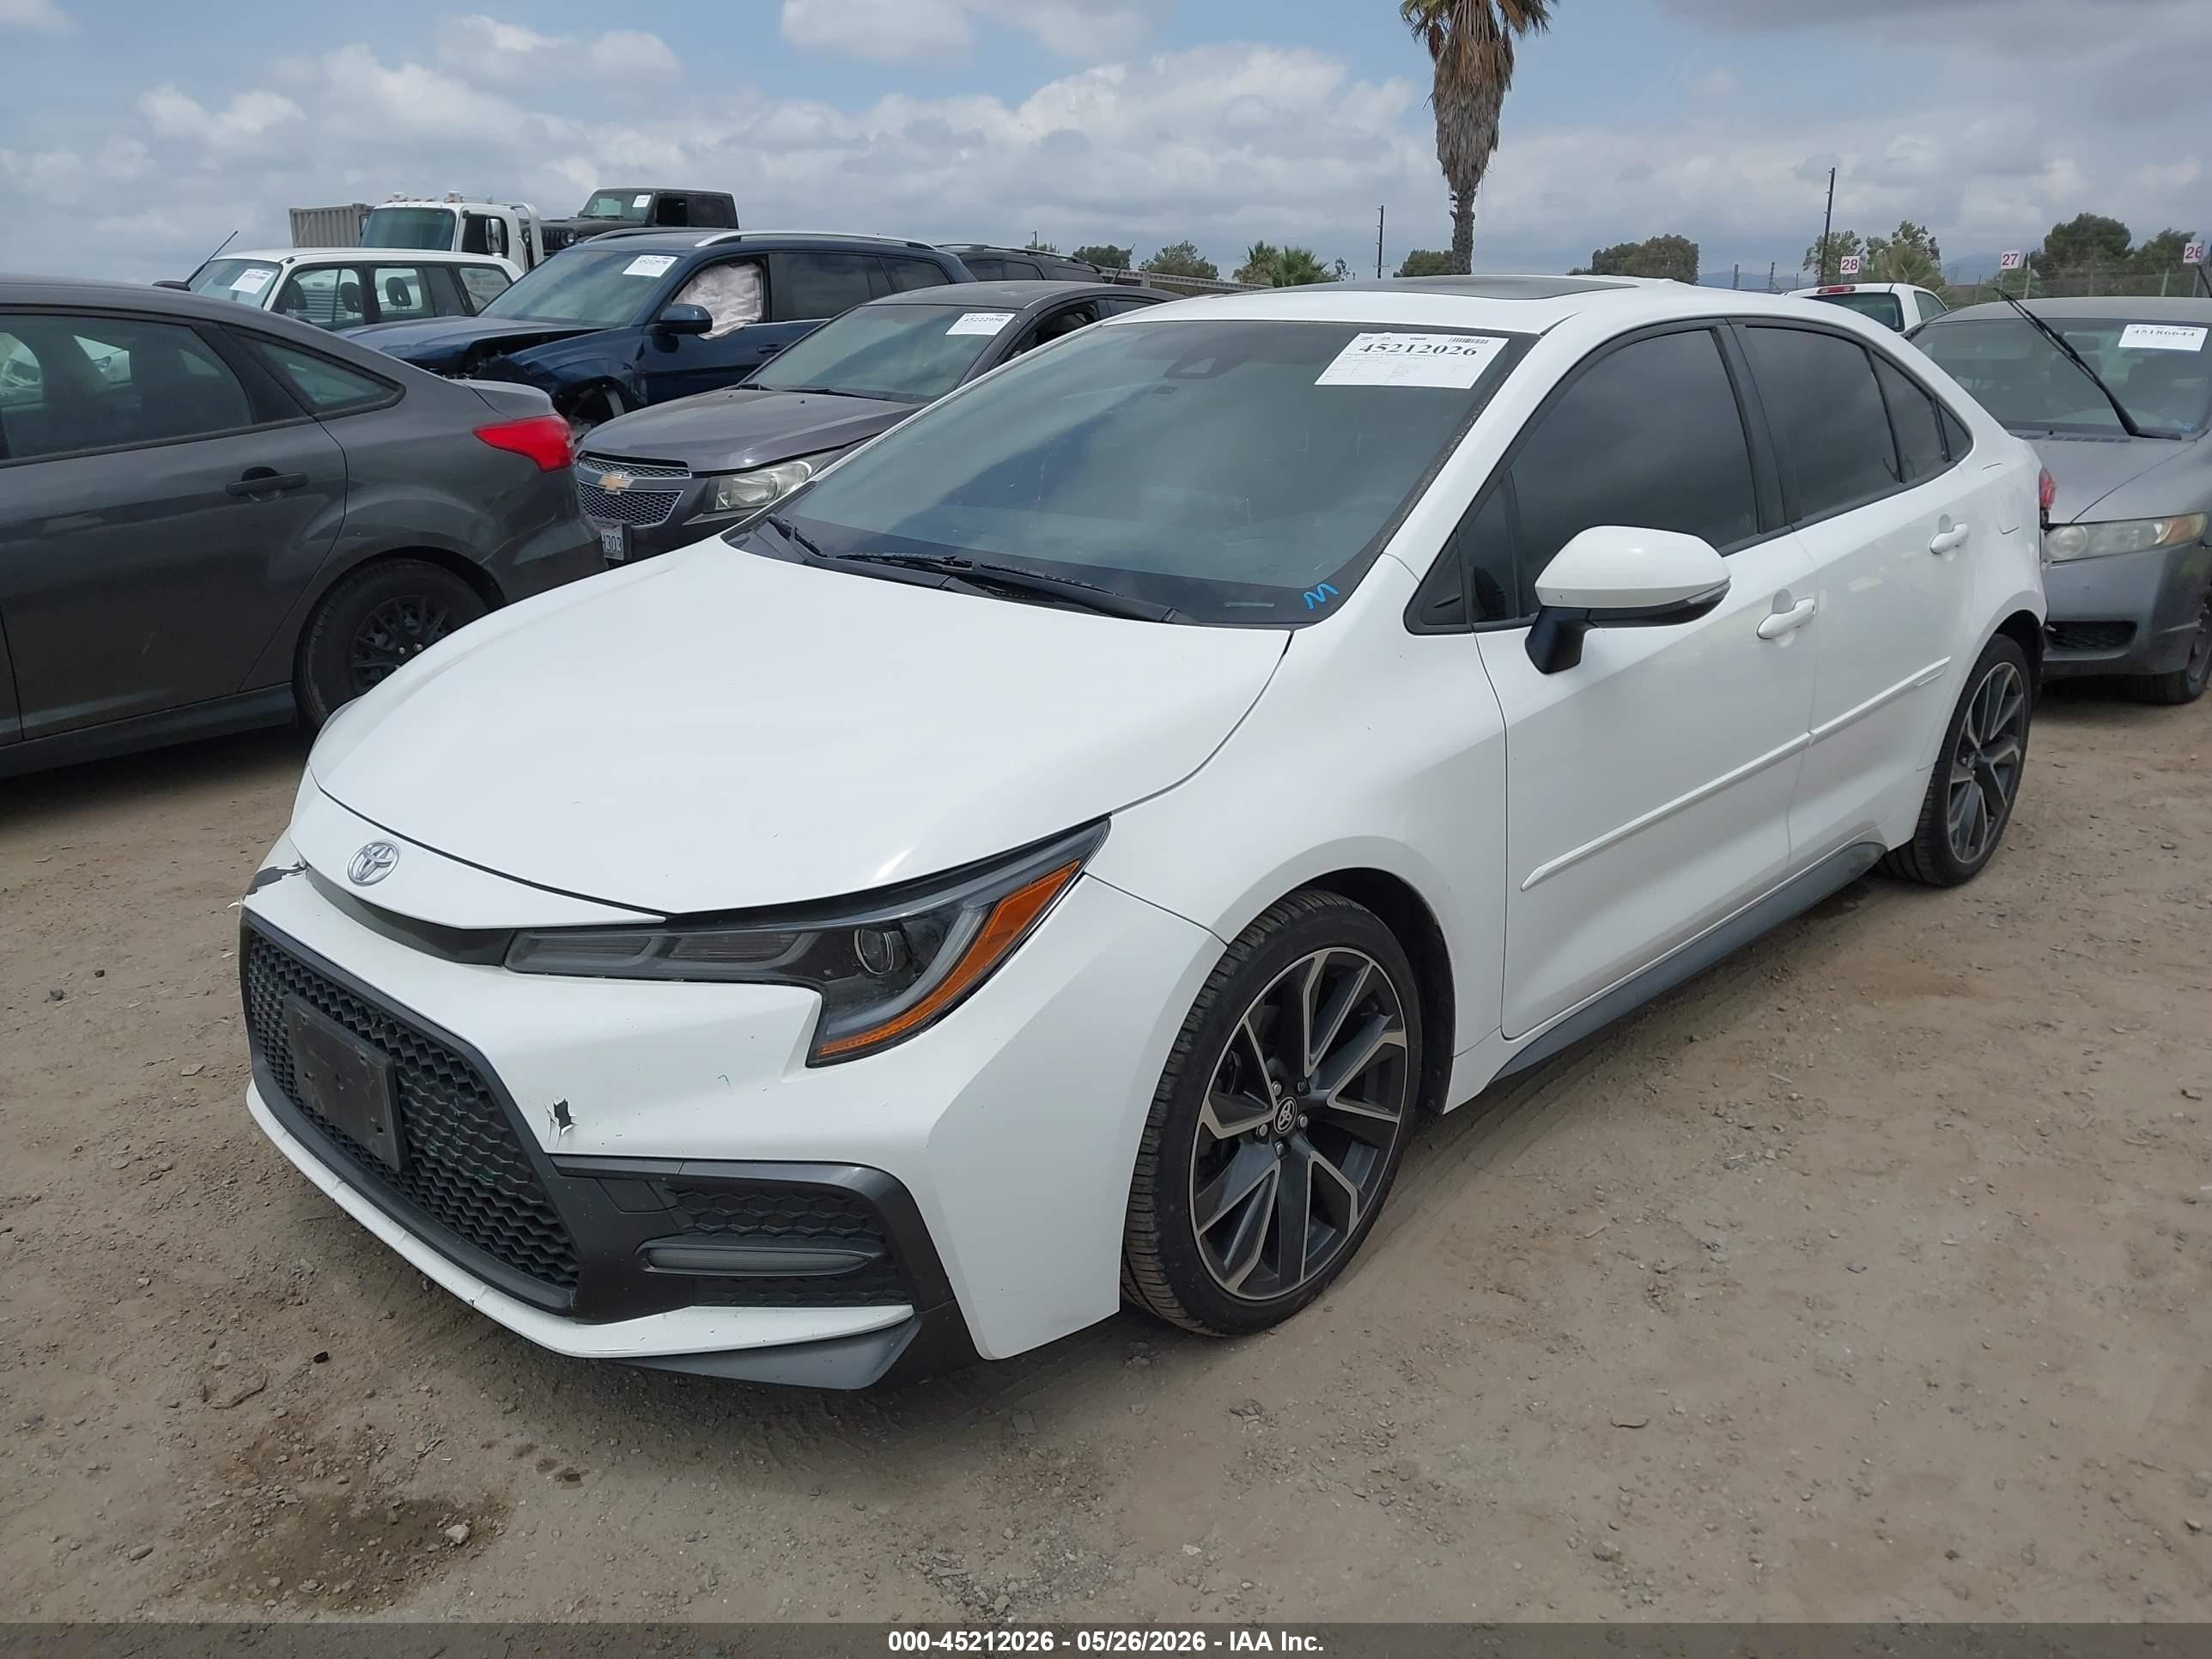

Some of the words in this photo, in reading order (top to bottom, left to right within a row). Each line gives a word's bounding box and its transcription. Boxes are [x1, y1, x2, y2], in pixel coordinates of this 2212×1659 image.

[1842, 259, 1858, 270] 28
[2001, 253, 2019, 266] 27
[1358, 343, 1478, 356] 45212026
